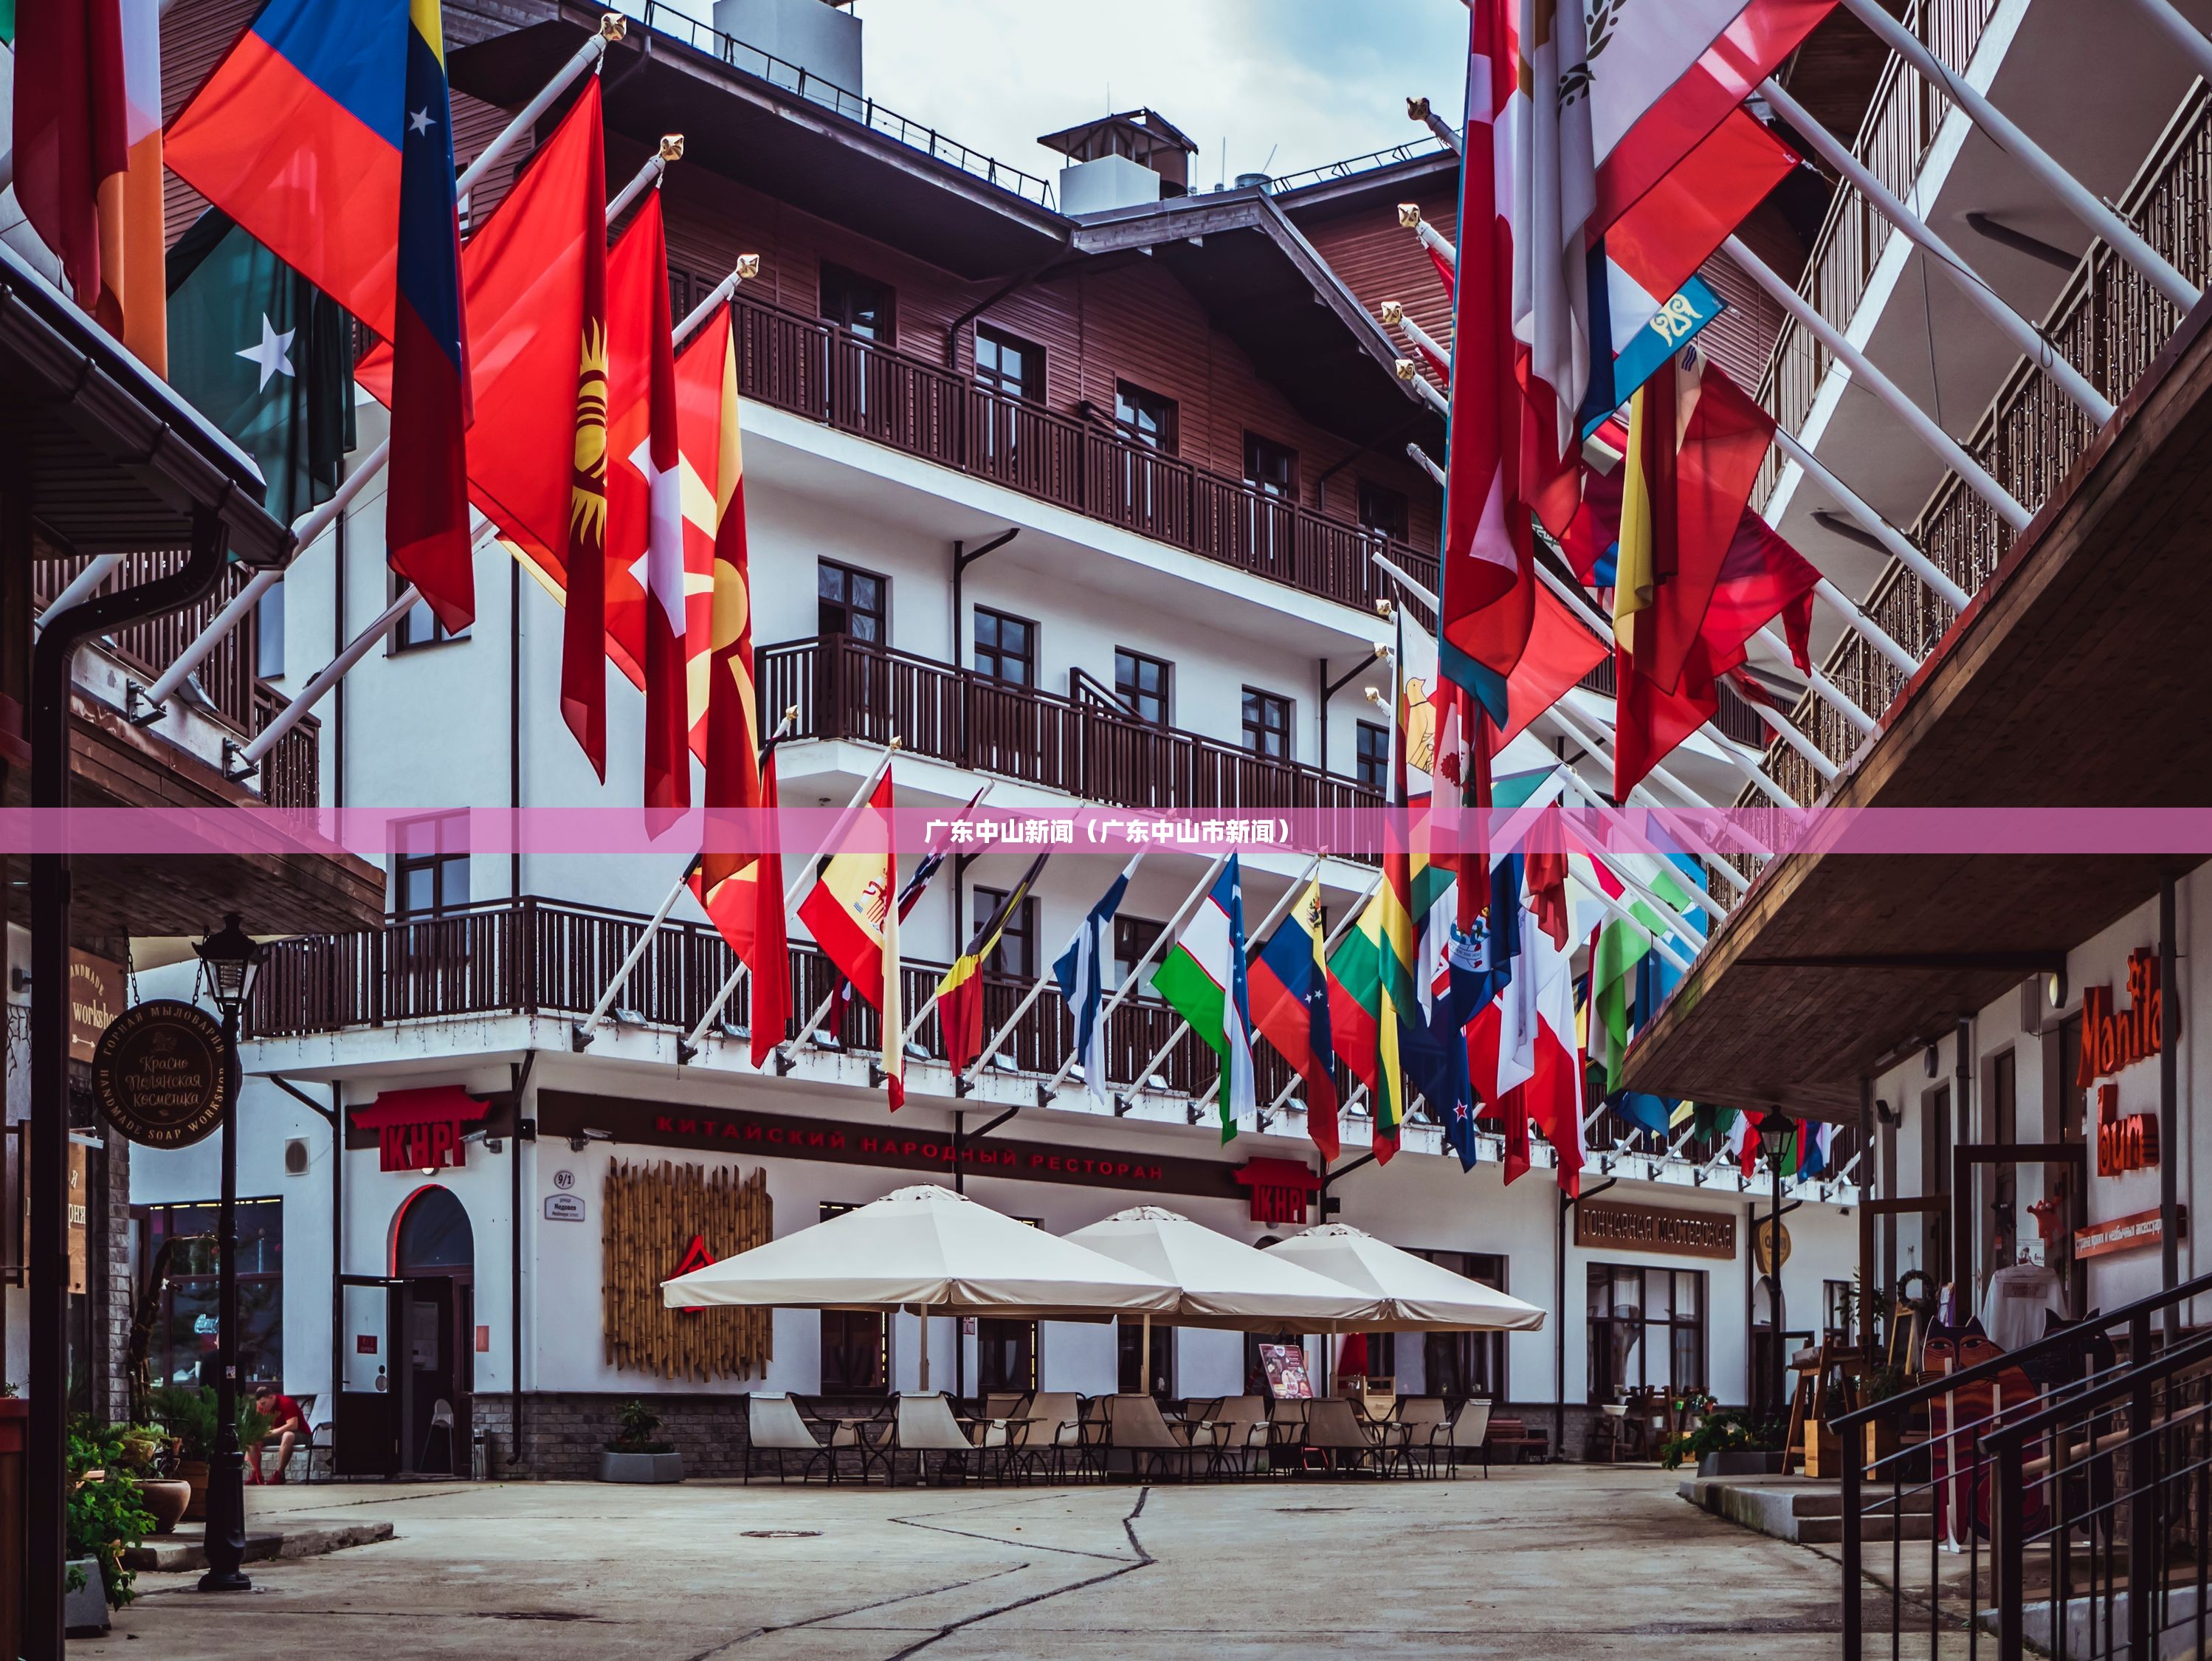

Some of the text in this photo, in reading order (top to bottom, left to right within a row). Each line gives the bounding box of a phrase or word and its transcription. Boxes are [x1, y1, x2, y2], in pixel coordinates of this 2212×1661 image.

[70, 963, 105, 997] ANDMADE
[72, 1000, 118, 1030] worksho
[103, 1006, 224, 1056] ГОРНАЯ МЫЛОВАРНЯ
[100, 1070, 142, 1135] HANDMADE
[148, 1129, 182, 1141] SOAP
[655, 1115, 1163, 1180] КИТАЙСКИЙ НАРОДНЫЙ РЕСТОРАН
[558, 1174, 571, 1186] 9/1
[1583, 1209, 1653, 1241] ГОНЧАРНАЯ
[1658, 1217, 1731, 1249] МАСТЕРСКАЯ
